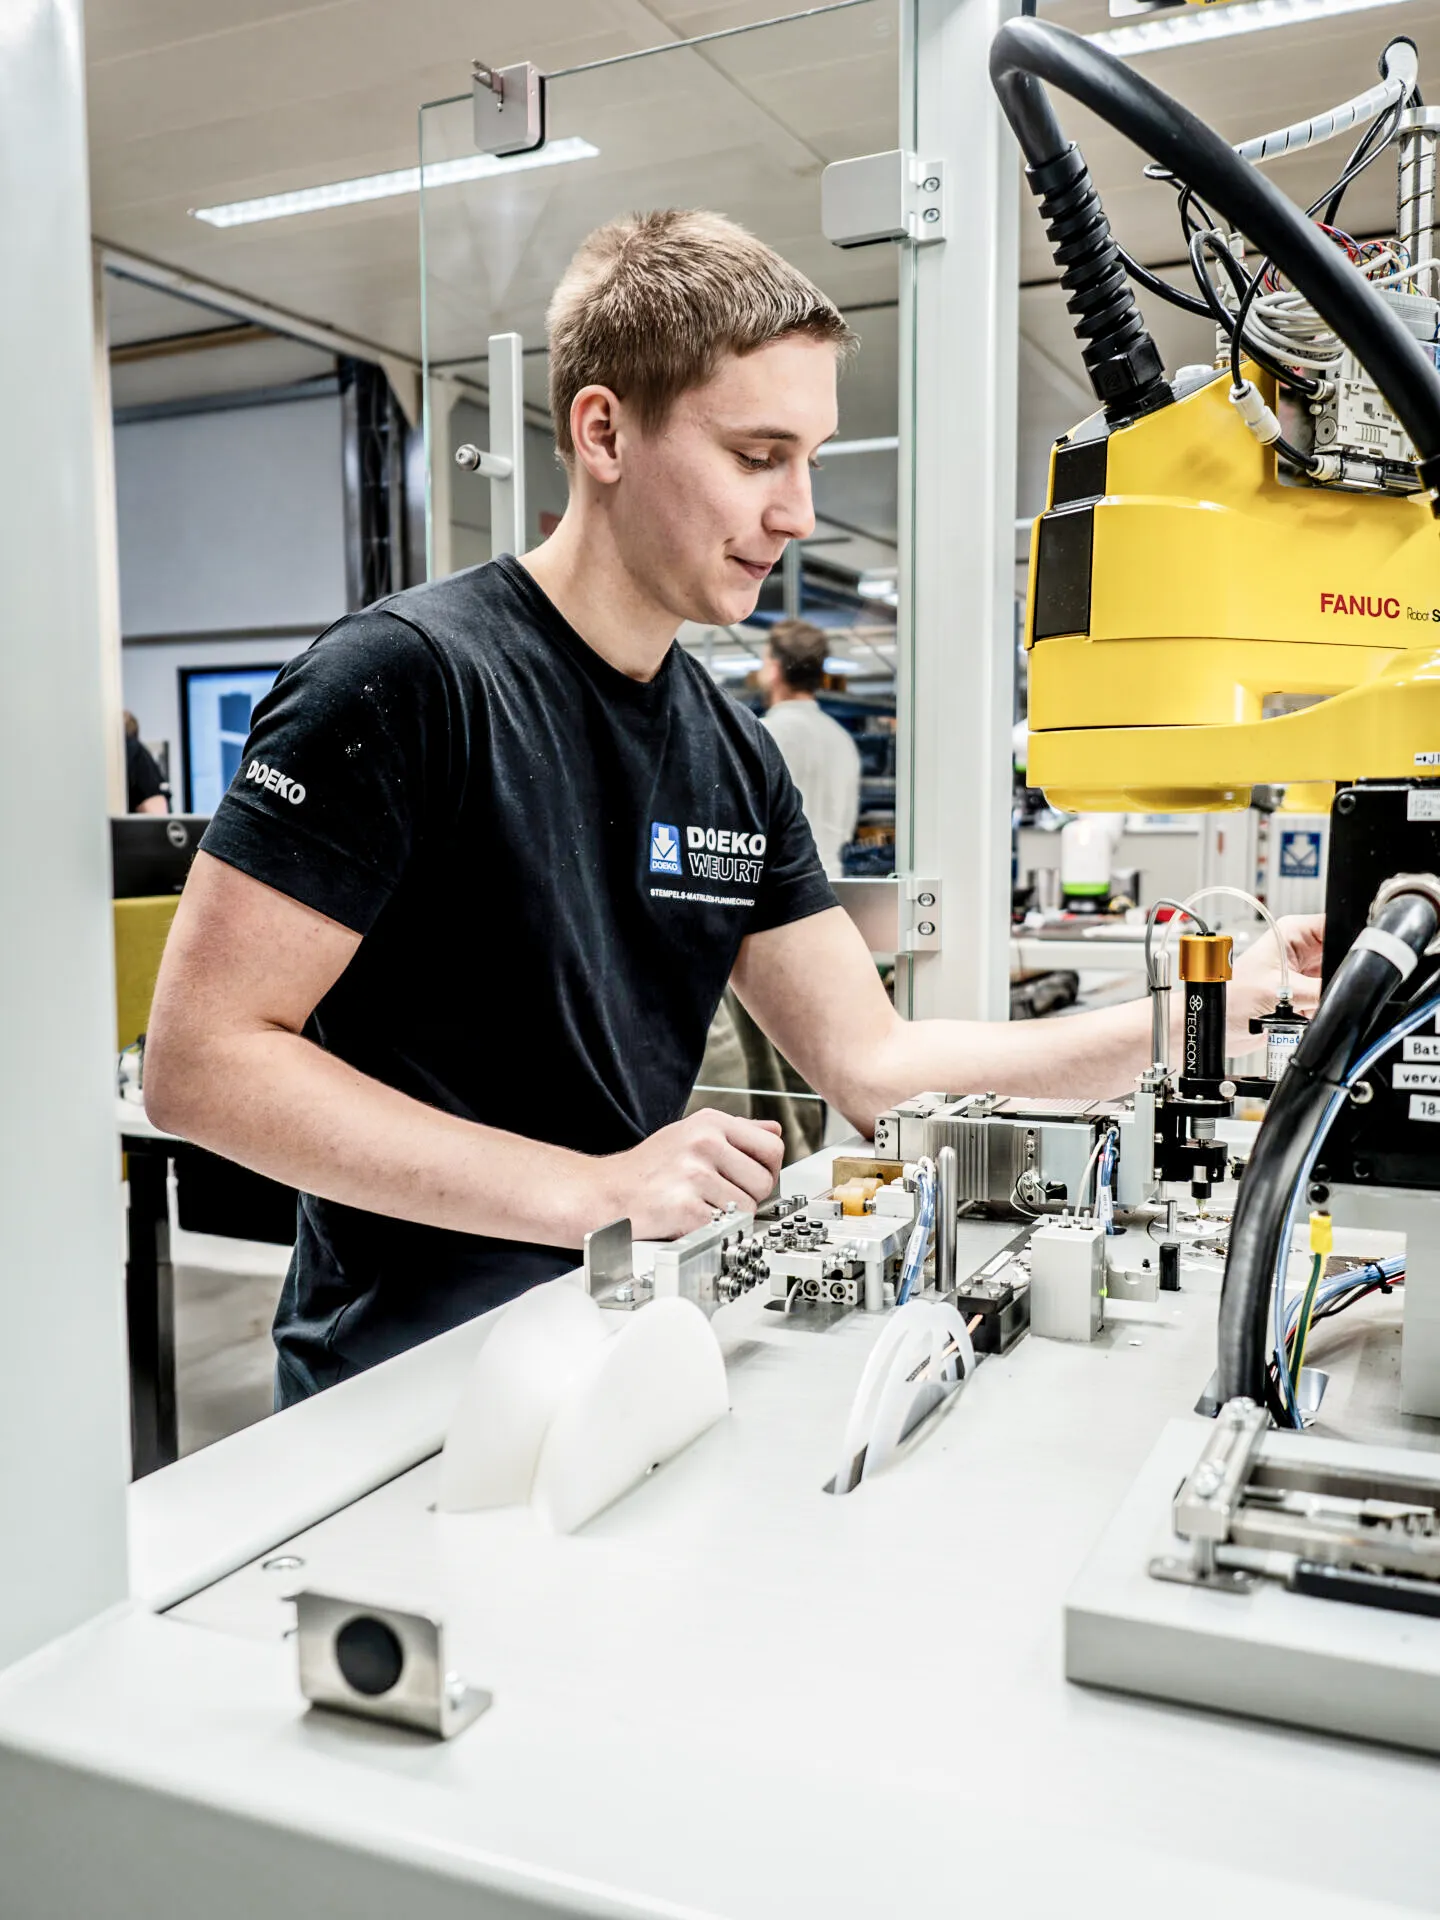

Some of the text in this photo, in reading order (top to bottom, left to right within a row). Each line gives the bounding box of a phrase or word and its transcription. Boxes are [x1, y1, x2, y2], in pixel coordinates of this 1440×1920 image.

[1320, 593, 1400, 619] FANUC
[1406, 606, 1430, 621] Robot
[246, 760, 306, 805] DOEKO
[687, 826, 767, 856] DOEKO
[652, 861, 678, 871] DOEKO
[688, 853, 764, 883] WEURT
[1187, 1011, 1197, 1071] TECHCON
[1403, 1074, 1440, 1083] verv
